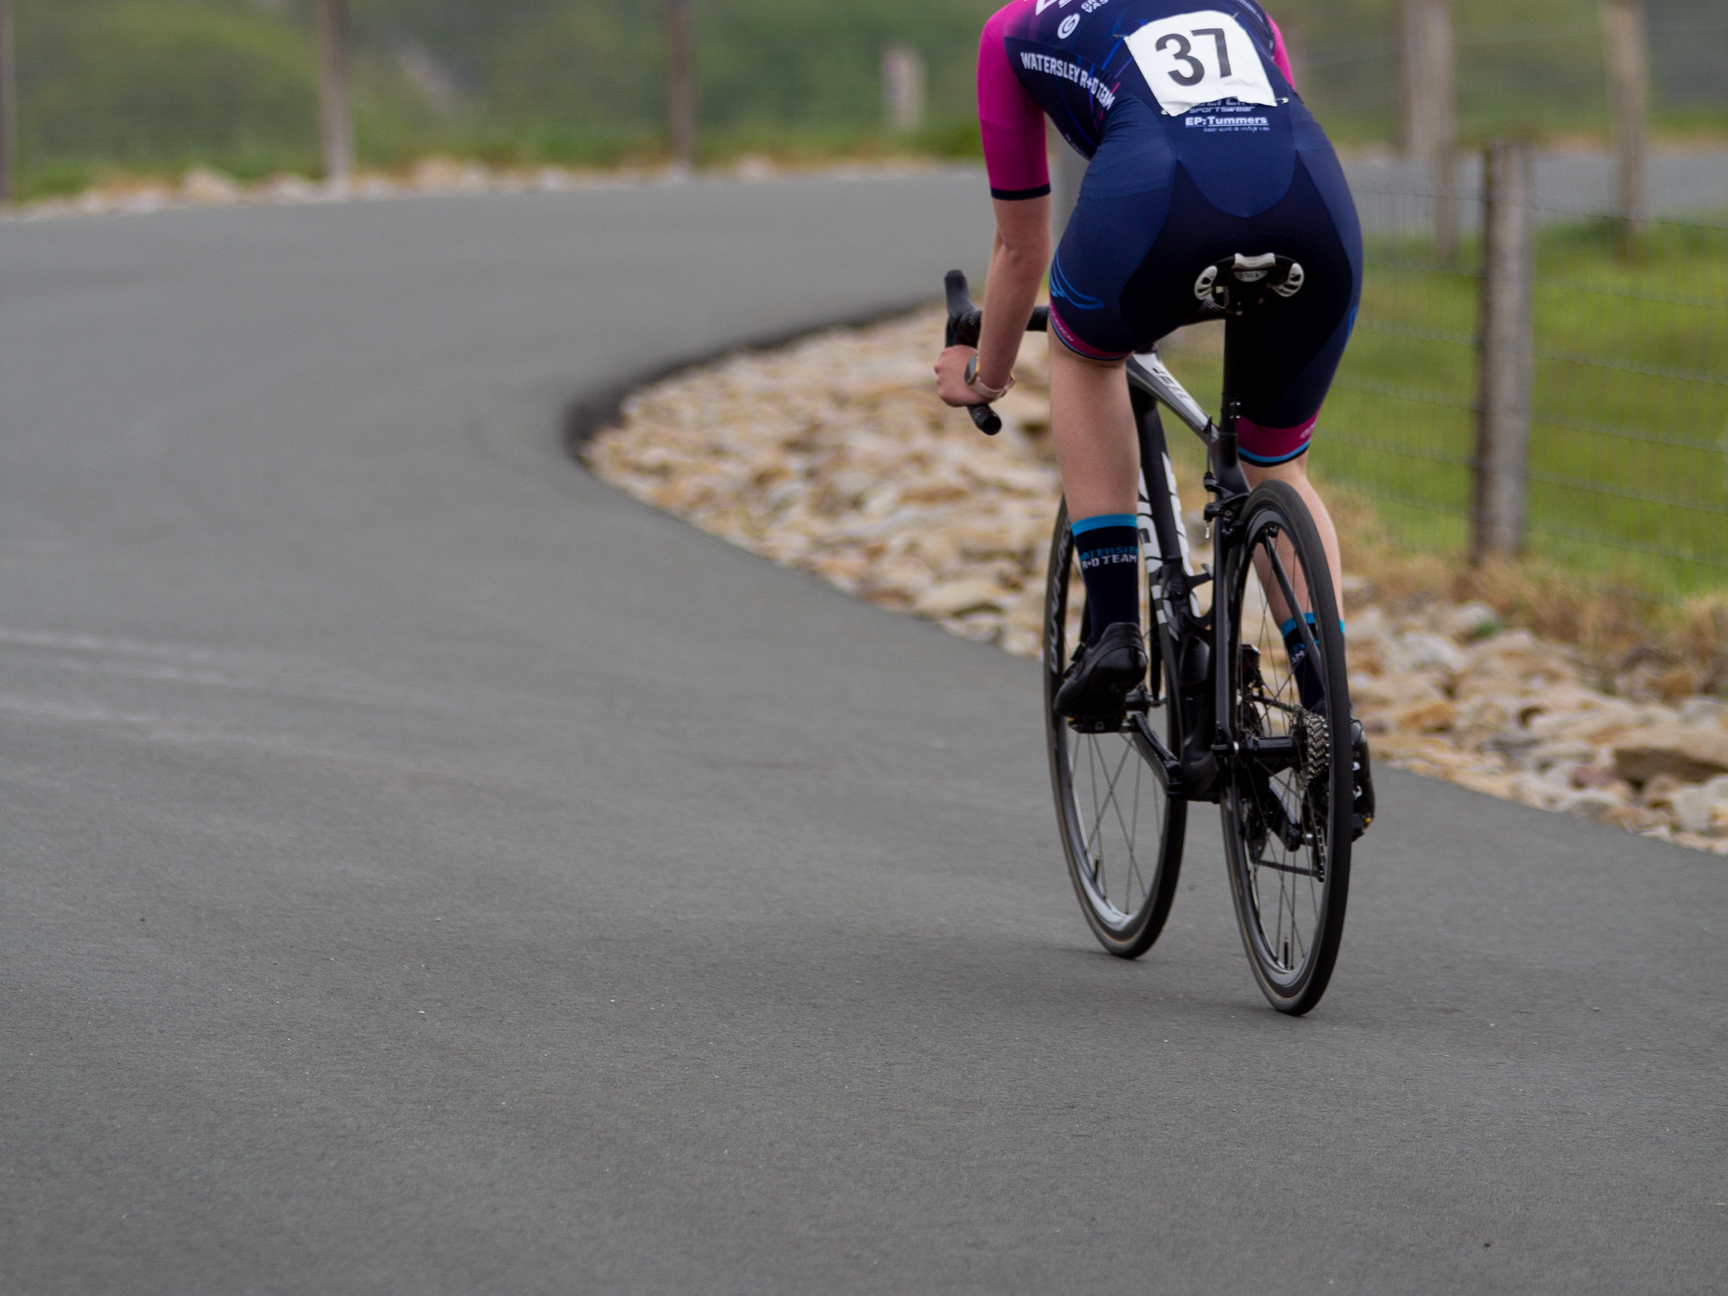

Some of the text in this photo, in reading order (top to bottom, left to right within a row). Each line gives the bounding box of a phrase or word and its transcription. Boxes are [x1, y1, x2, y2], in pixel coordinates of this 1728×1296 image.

[1020, 52, 1115, 111] WATERSLEY R+D TEAM
[1155, 28, 1232, 86] 37
[1101, 553, 1137, 565] TEAM
